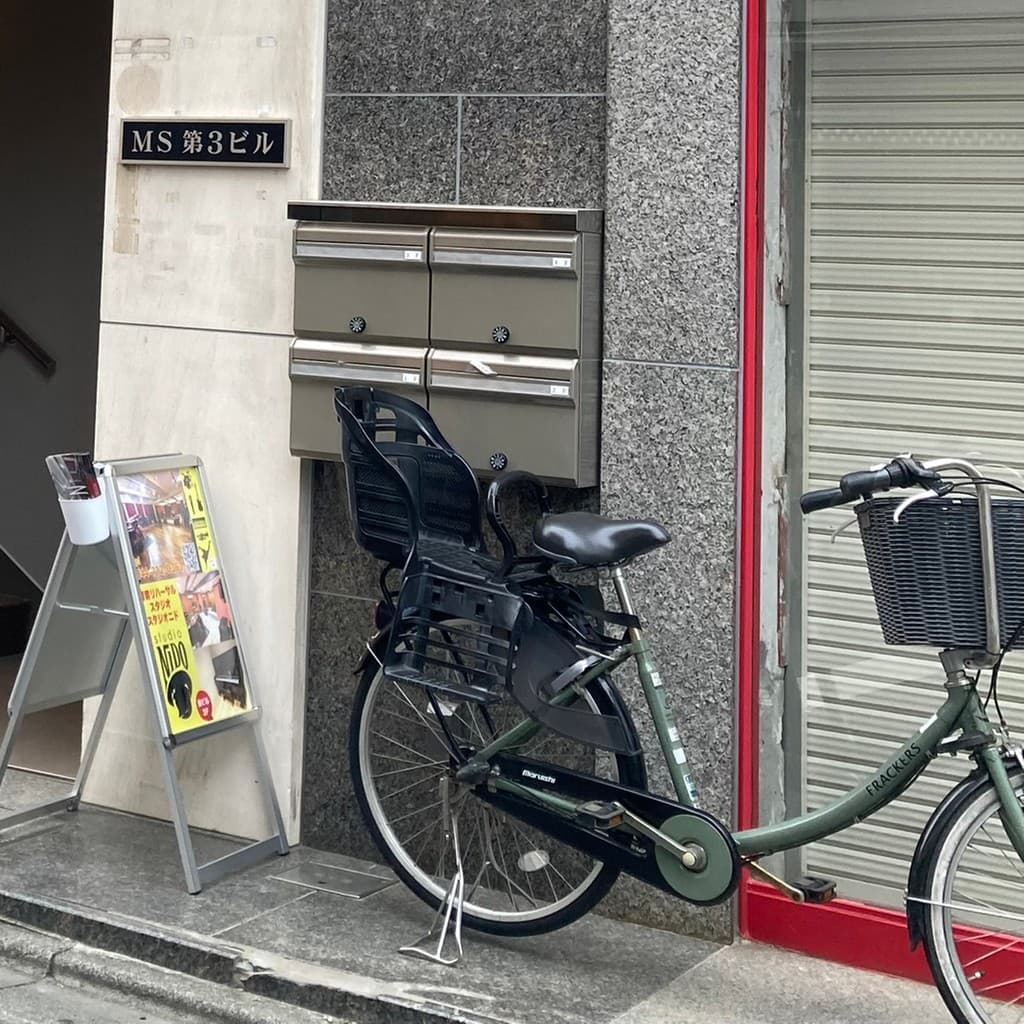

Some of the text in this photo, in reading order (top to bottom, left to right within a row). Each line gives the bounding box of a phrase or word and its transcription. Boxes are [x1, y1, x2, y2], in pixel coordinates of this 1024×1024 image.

[131, 129, 274, 155] MS 第3ビル
[865, 742, 921, 796] FRACKERS
